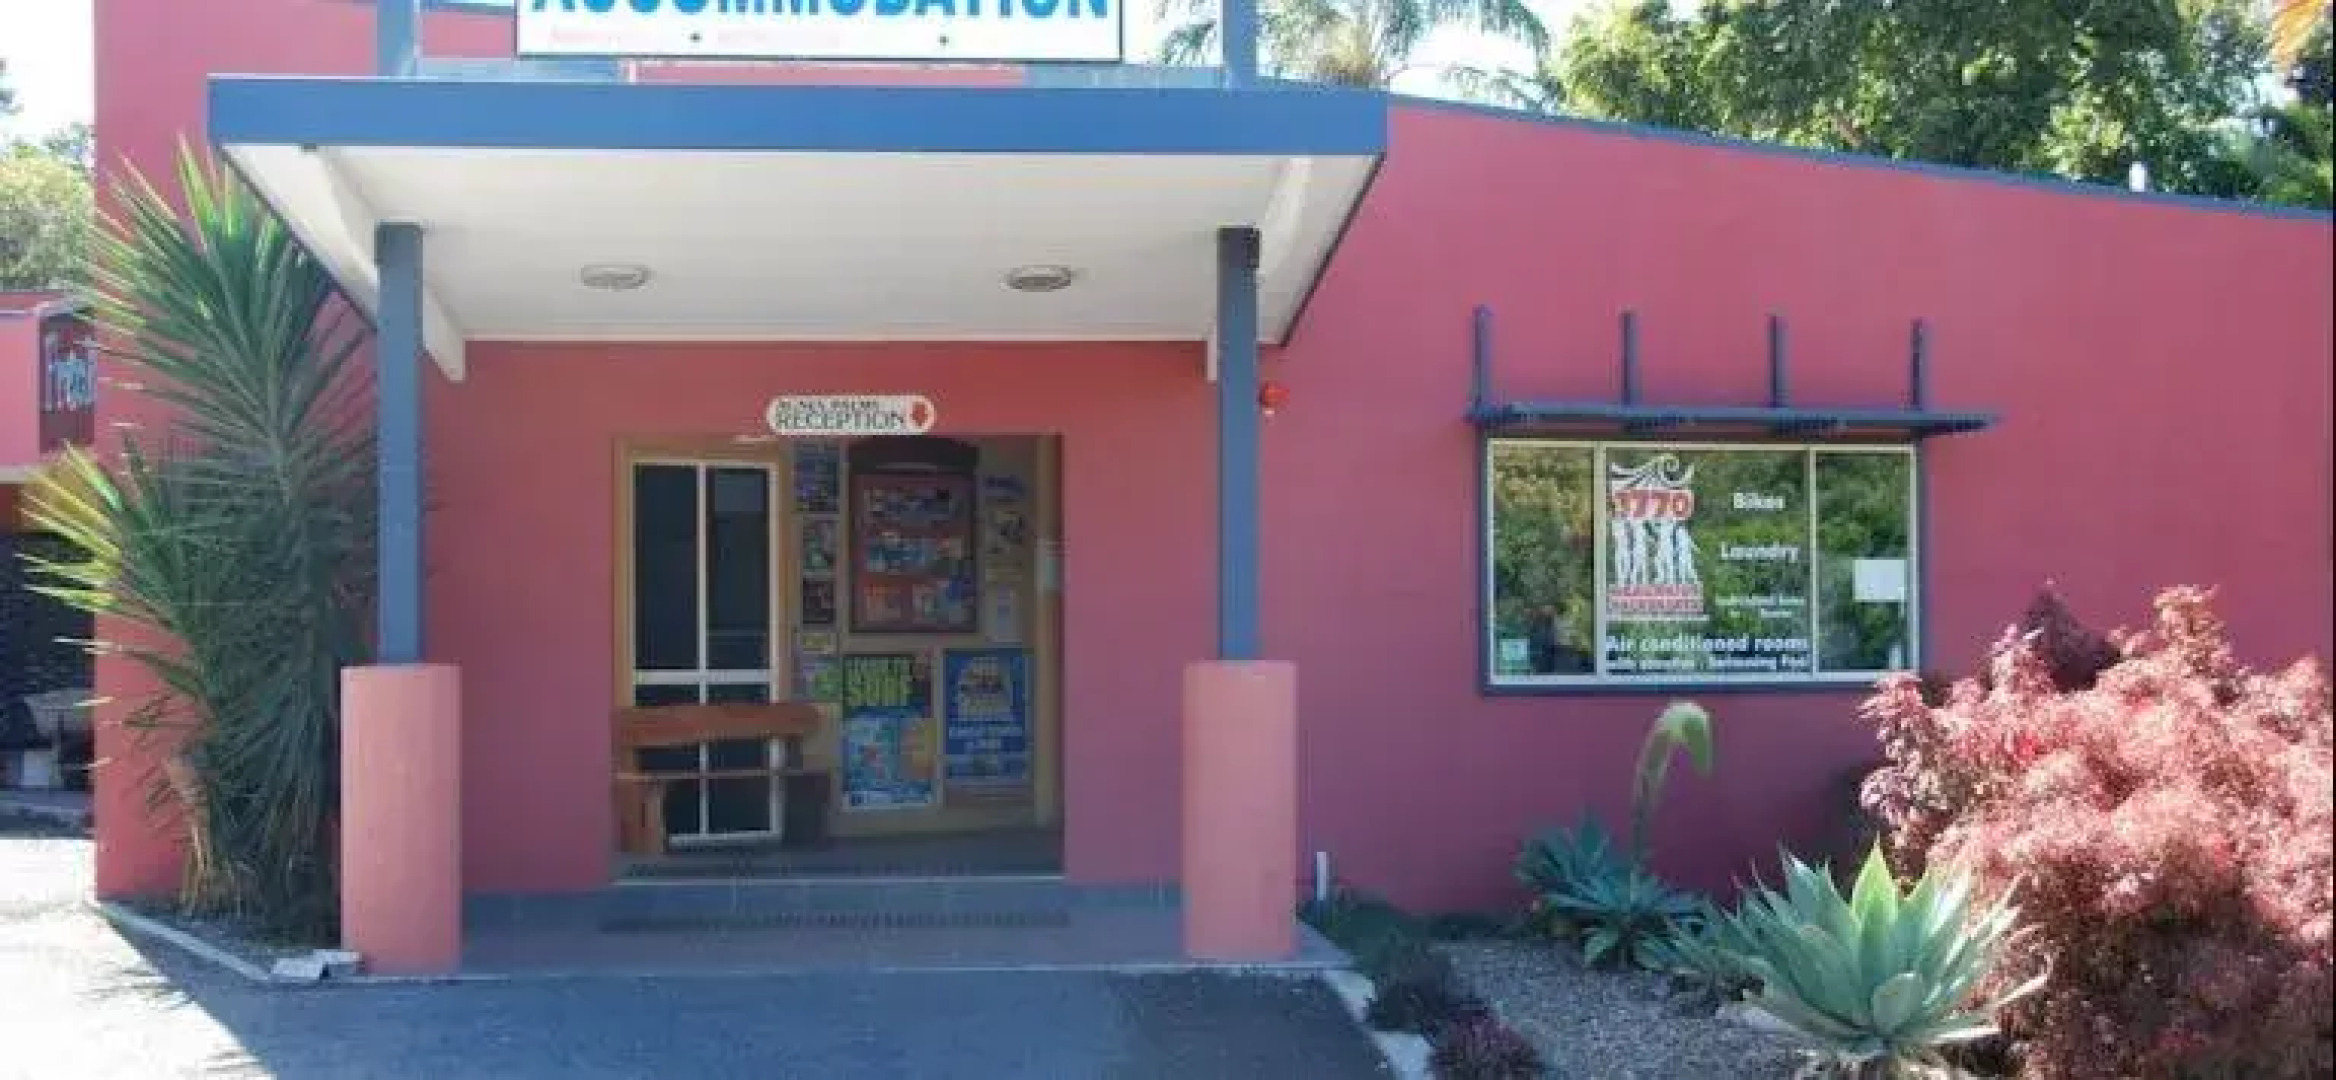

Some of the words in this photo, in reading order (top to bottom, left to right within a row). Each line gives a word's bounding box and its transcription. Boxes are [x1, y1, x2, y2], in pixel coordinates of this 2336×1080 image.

[775, 411, 904, 430] RECEPTION
[1612, 490, 1692, 519] 1770
[1733, 491, 1786, 509] Bikes
[1721, 541, 1800, 564] Laundry
[1606, 634, 1636, 651] Air
[1639, 633, 1750, 652] conditioned
[1754, 637, 1809, 652] rooms
[848, 671, 912, 707] SURF
